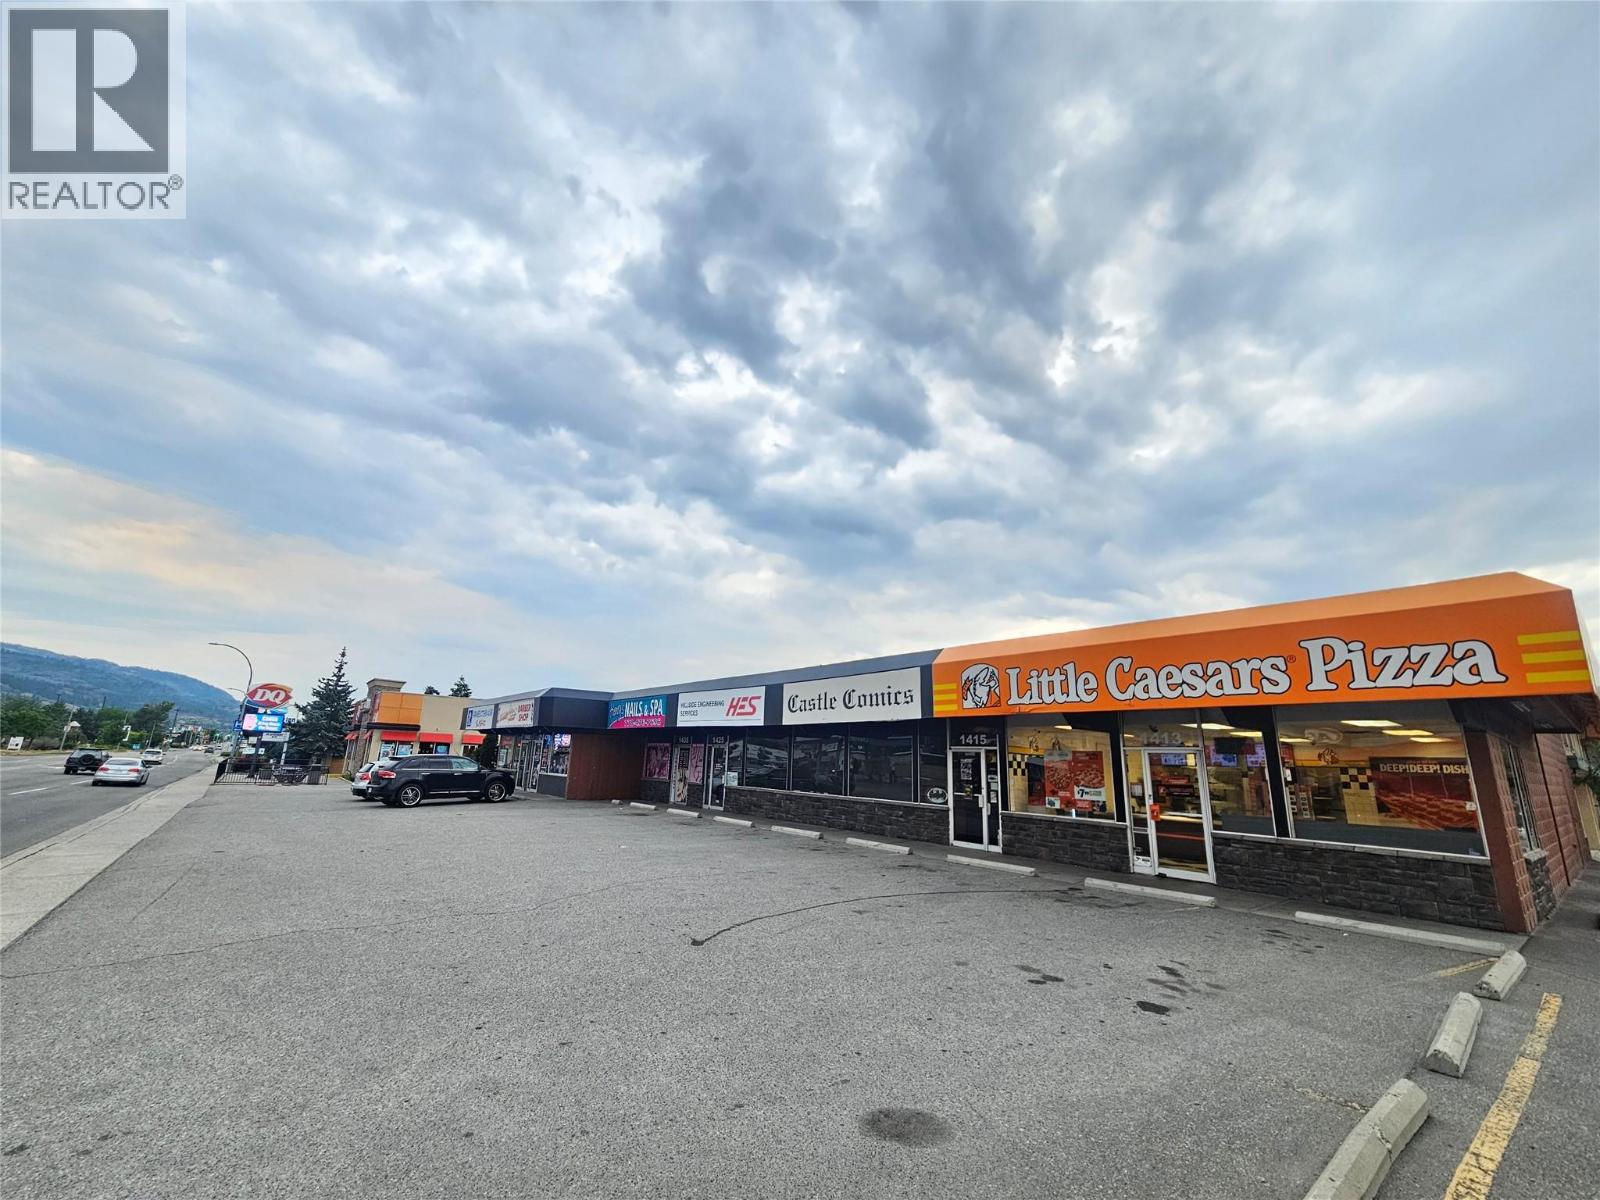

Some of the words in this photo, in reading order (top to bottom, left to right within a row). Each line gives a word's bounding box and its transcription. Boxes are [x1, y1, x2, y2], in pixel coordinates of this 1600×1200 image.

[1005, 661, 1098, 707] Little
[1298, 636, 1508, 691] Pizza
[253, 689, 286, 704] DQ
[787, 694, 837, 713] Castle
[843, 685, 914, 709] Comics
[625, 701, 643, 717] NAILS
[650, 699, 663, 716] SPA
[726, 695, 761, 716] HES
[960, 734, 986, 745] 1415
[1140, 732, 1182, 745] 1413
[1443, 765, 1469, 774] DISH
